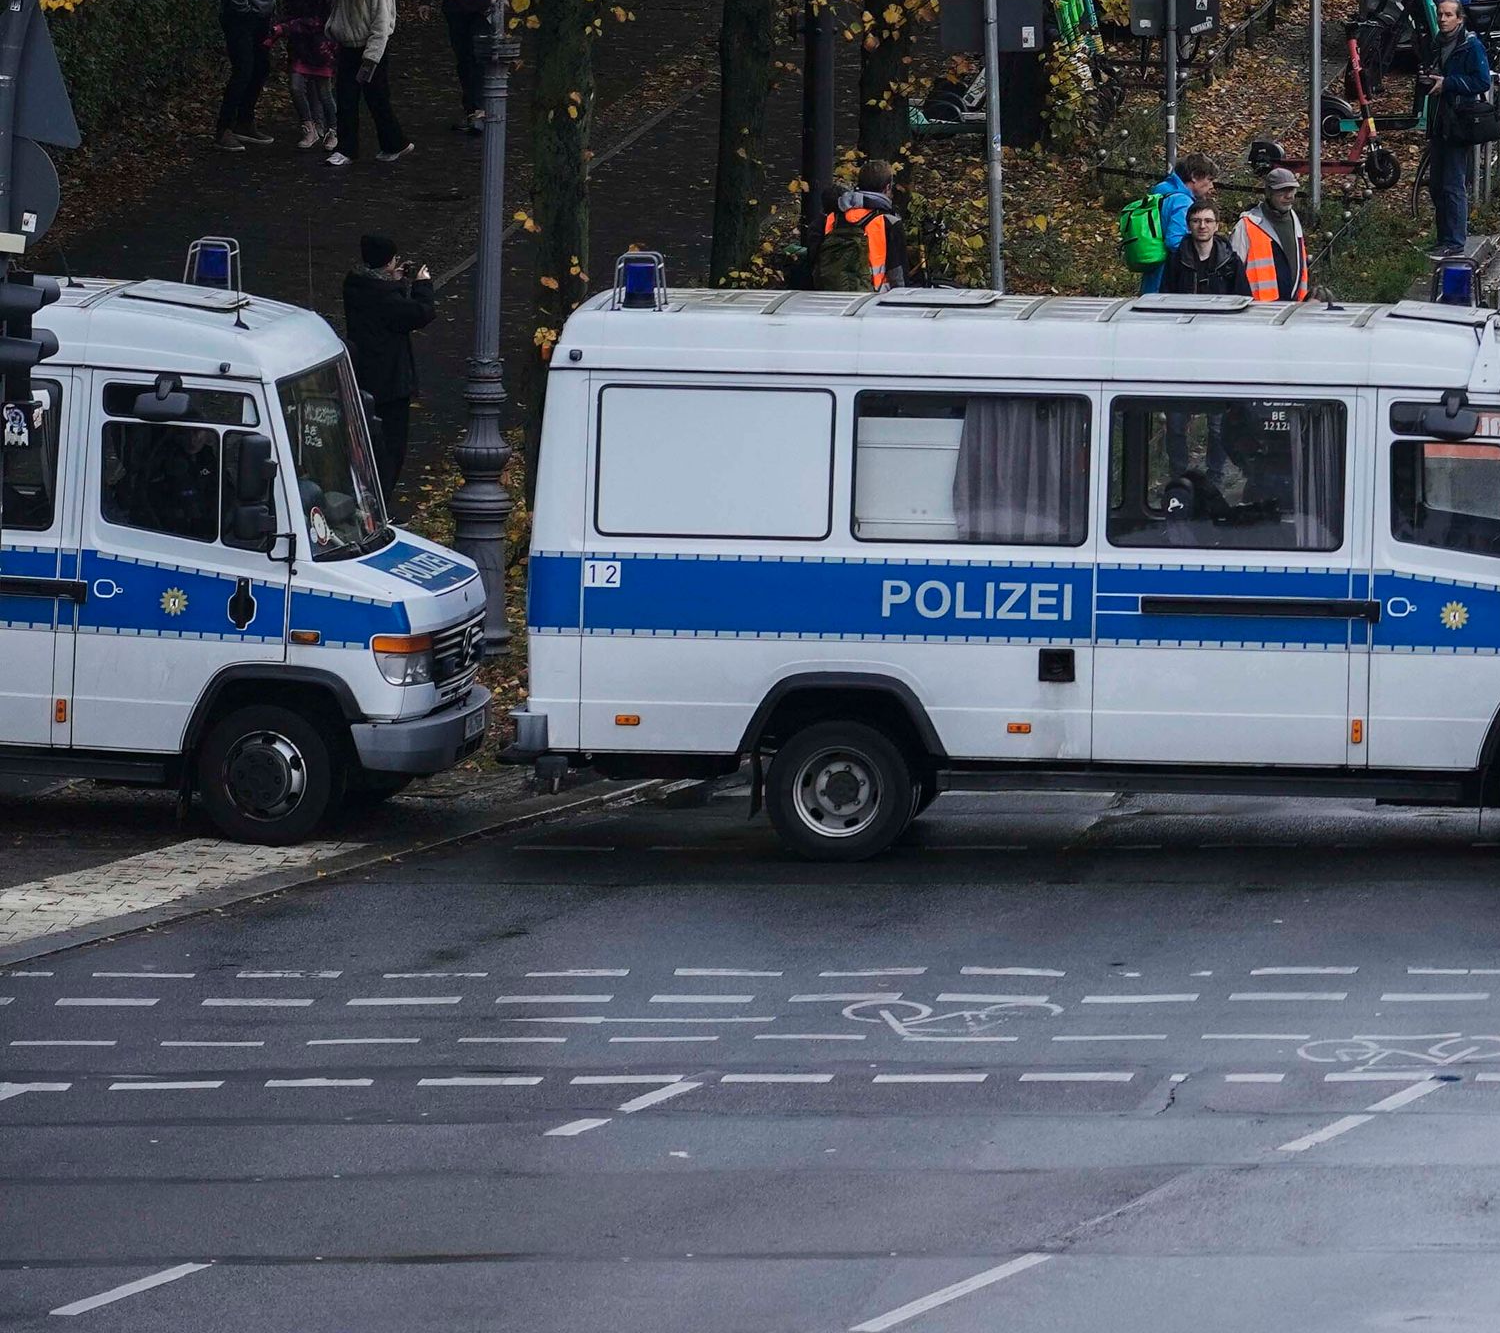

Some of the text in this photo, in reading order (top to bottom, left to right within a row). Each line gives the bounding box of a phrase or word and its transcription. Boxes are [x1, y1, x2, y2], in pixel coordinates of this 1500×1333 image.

[1272, 411, 1286, 421] BE
[390, 553, 458, 582] POLIZEI
[589, 564, 617, 585] 12
[881, 579, 1073, 621] POLIZEI
